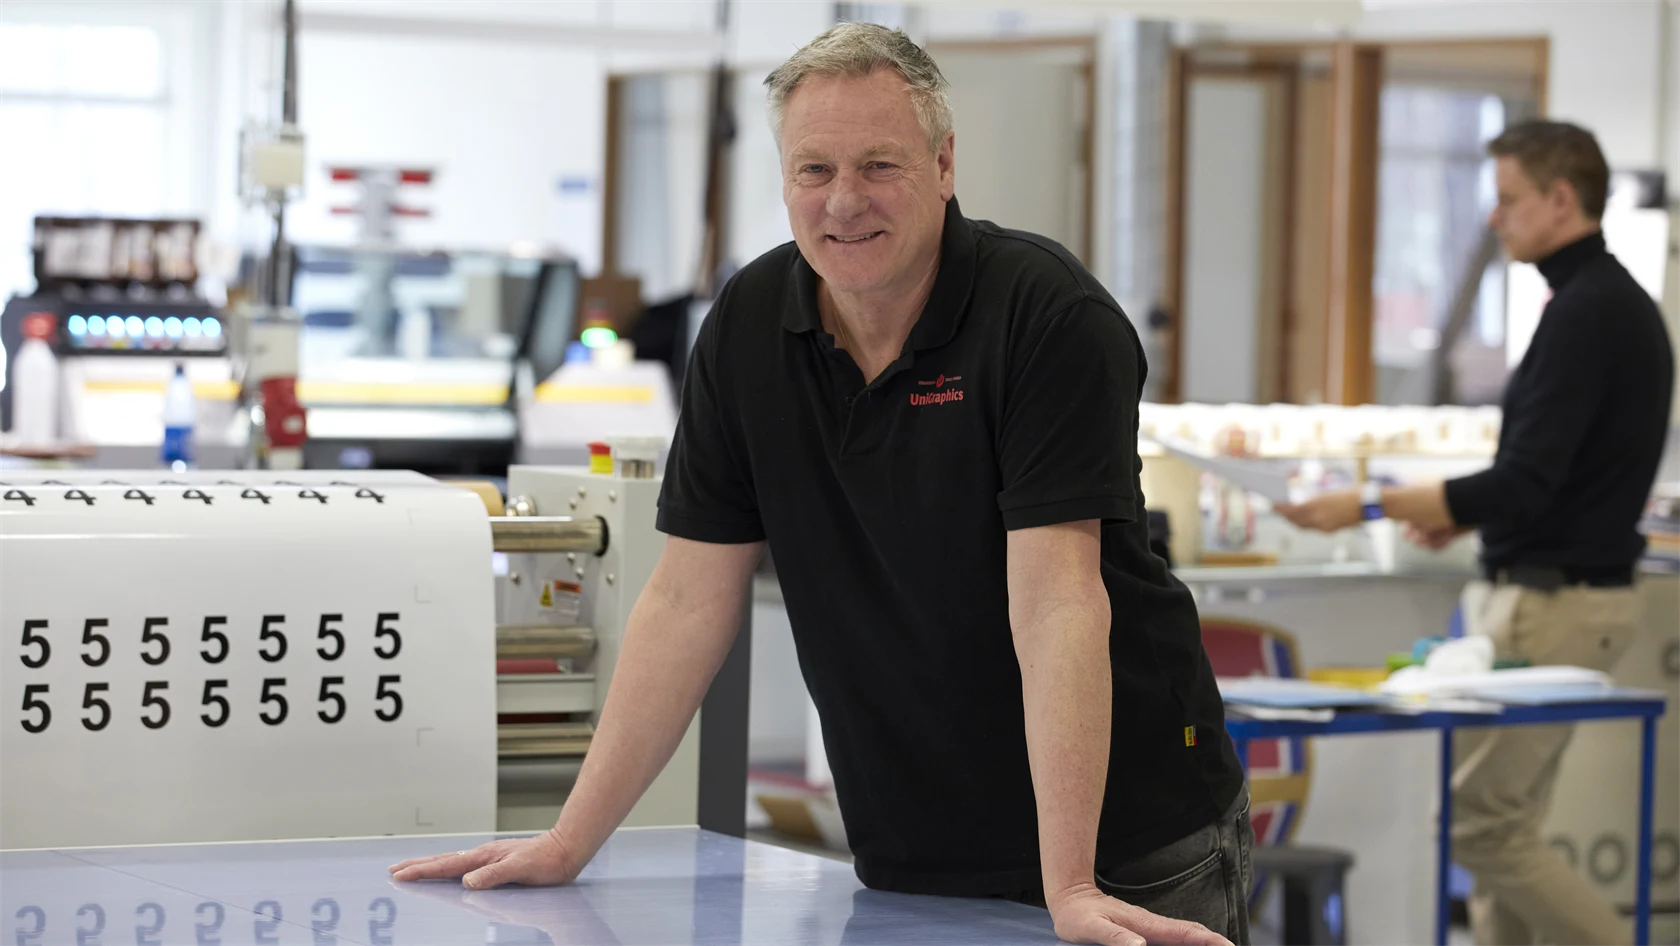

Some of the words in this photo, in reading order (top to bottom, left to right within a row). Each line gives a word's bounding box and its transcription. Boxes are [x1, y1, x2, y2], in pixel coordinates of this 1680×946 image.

[910, 388, 964, 406] UniGraphics
[4, 490, 37, 506] 4
[64, 489, 96, 506] 4
[124, 489, 156, 505] 4
[183, 489, 214, 505] 4
[241, 488, 272, 504] 4
[298, 489, 329, 504] 4
[355, 488, 385, 503] 4
[20, 619, 51, 669] 5
[81, 618, 111, 668] 5
[140, 617, 171, 666] 5
[200, 615, 230, 665] 5
[258, 614, 288, 663] 5
[316, 613, 346, 662] 5
[373, 612, 402, 660] 5
[20, 683, 52, 734] 5
[81, 682, 112, 732] 5
[140, 680, 171, 730] 5
[200, 679, 231, 728] 5
[259, 677, 289, 727] 5
[317, 676, 347, 725] 5
[374, 674, 403, 723] 5
